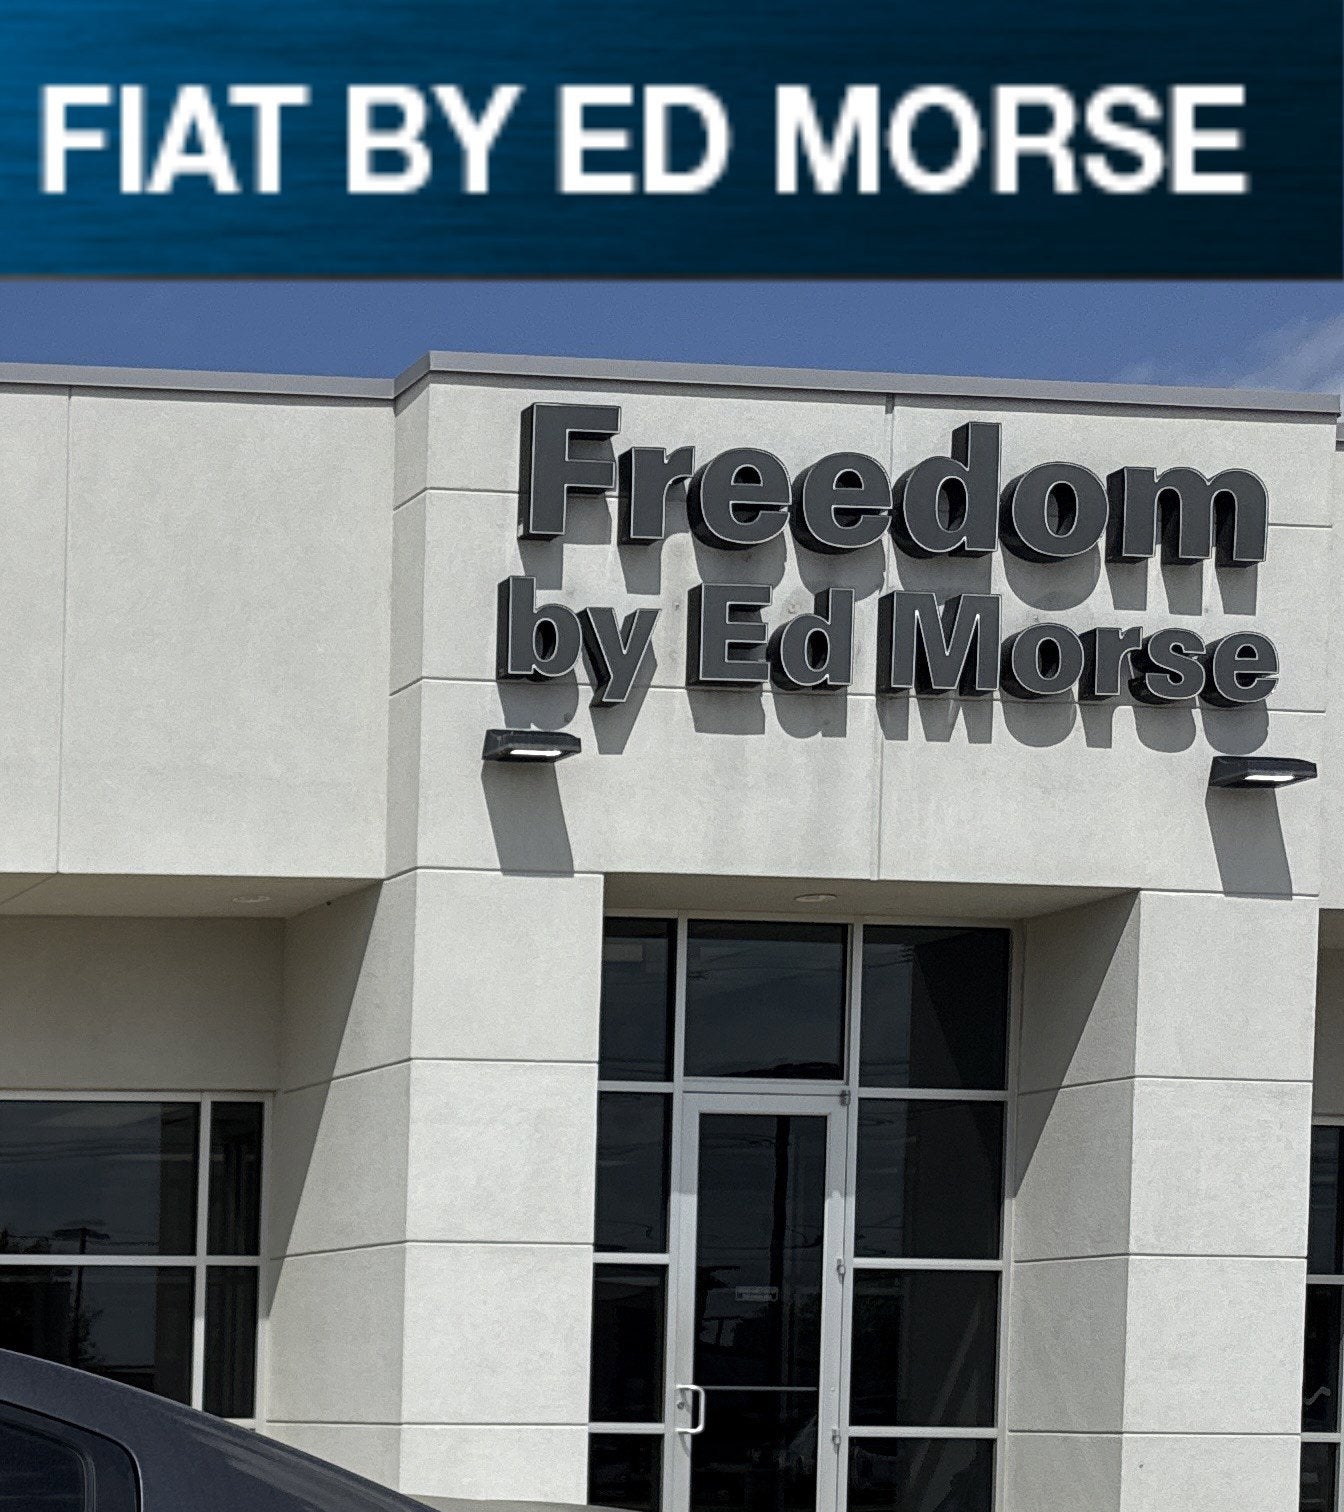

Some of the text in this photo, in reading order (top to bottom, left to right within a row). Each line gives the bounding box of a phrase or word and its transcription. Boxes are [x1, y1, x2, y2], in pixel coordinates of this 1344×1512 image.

[518, 402, 1268, 563] Freedom
[496, 575, 1281, 704] by Ed Morse
